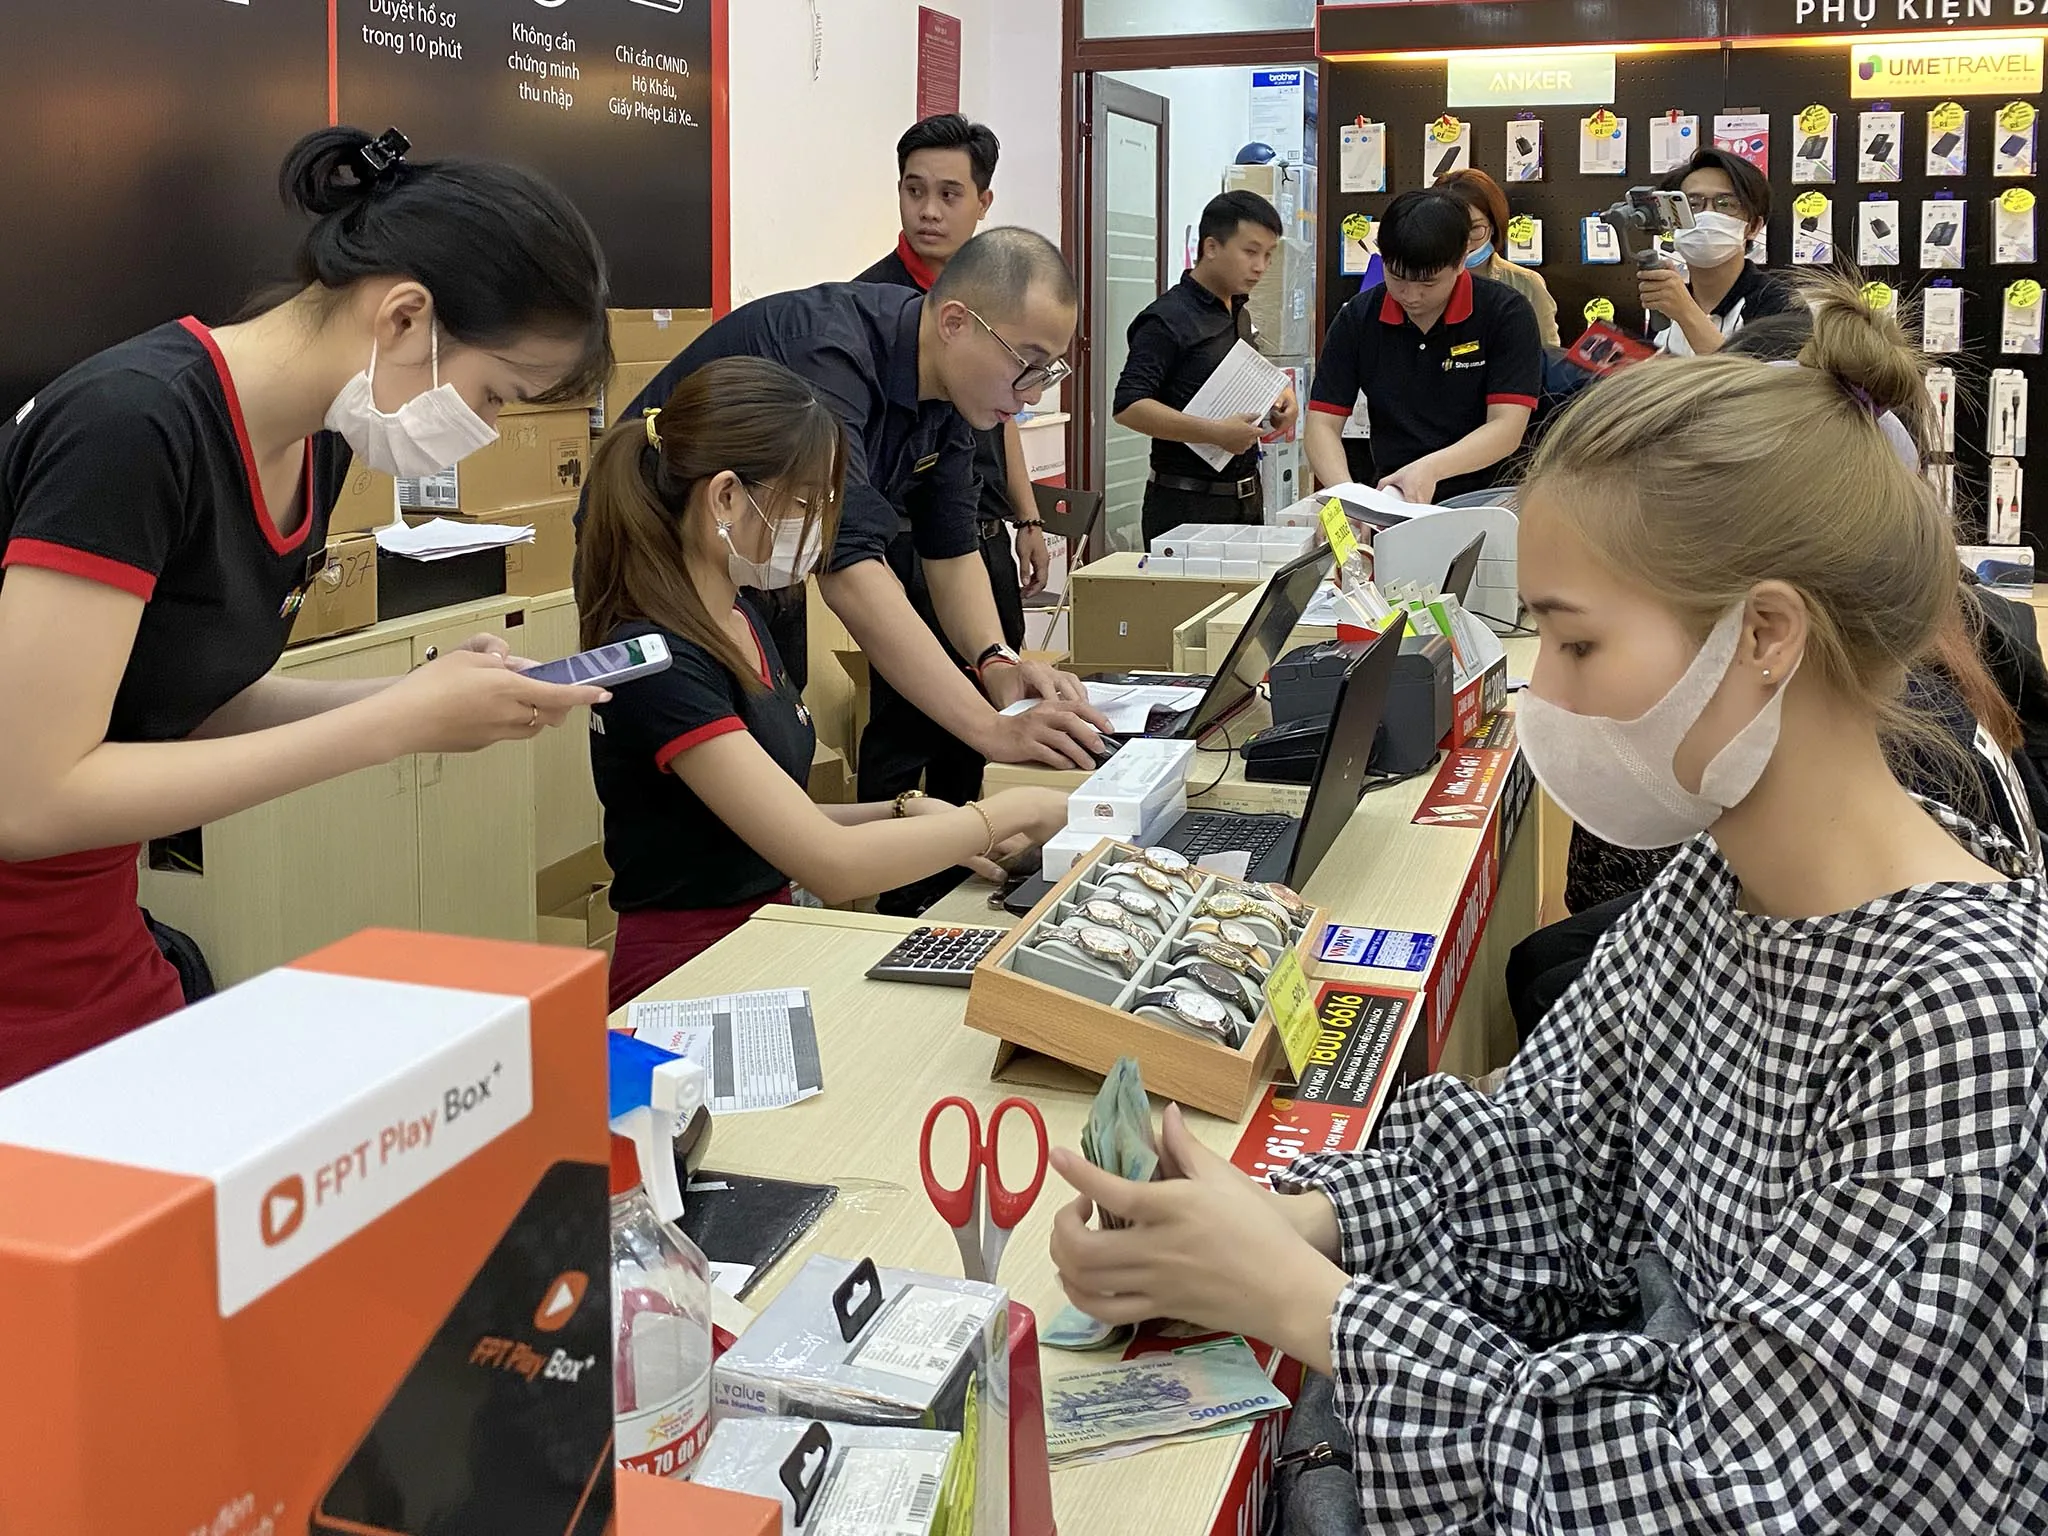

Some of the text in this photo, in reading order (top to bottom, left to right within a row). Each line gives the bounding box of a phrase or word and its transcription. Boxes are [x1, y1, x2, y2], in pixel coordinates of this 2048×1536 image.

[369, 0, 457, 28] Duyệt hồ sơ
[1796, 0, 1876, 28] PHỤ
[2013, 0, 2048, 16] B
[361, 24, 463, 60] trong 10 phút
[512, 22, 576, 52] Không cần
[508, 51, 580, 80] chứng minh
[615, 45, 690, 78] Chỉ cần CMND,
[1889, 54, 2036, 76] UMETRAVEL
[632, 74, 678, 101] Hộ Khẩu,
[1269, 73, 1298, 81] brother
[1489, 71, 1573, 91] ANKER
[519, 81, 573, 110] thu nhập
[608, 97, 698, 127] Giấy Phép Lái Xe...
[1304, 995, 1363, 1099] GỌI NGAY 1800 6616
[1337, 1008, 1385, 1089] ĐỂ NHẬN QUÀ TẶNG NẾU QUÝ KHÁCH
[1324, 1133, 1345, 1147] CHỊ
[315, 1139, 372, 1207] FPT
[379, 1109, 438, 1165] Play
[468, 1336, 514, 1369] FPT
[503, 1341, 548, 1384] Play
[1188, 1396, 1270, 1421] 500000
[654, 1450, 674, 1476] 70
